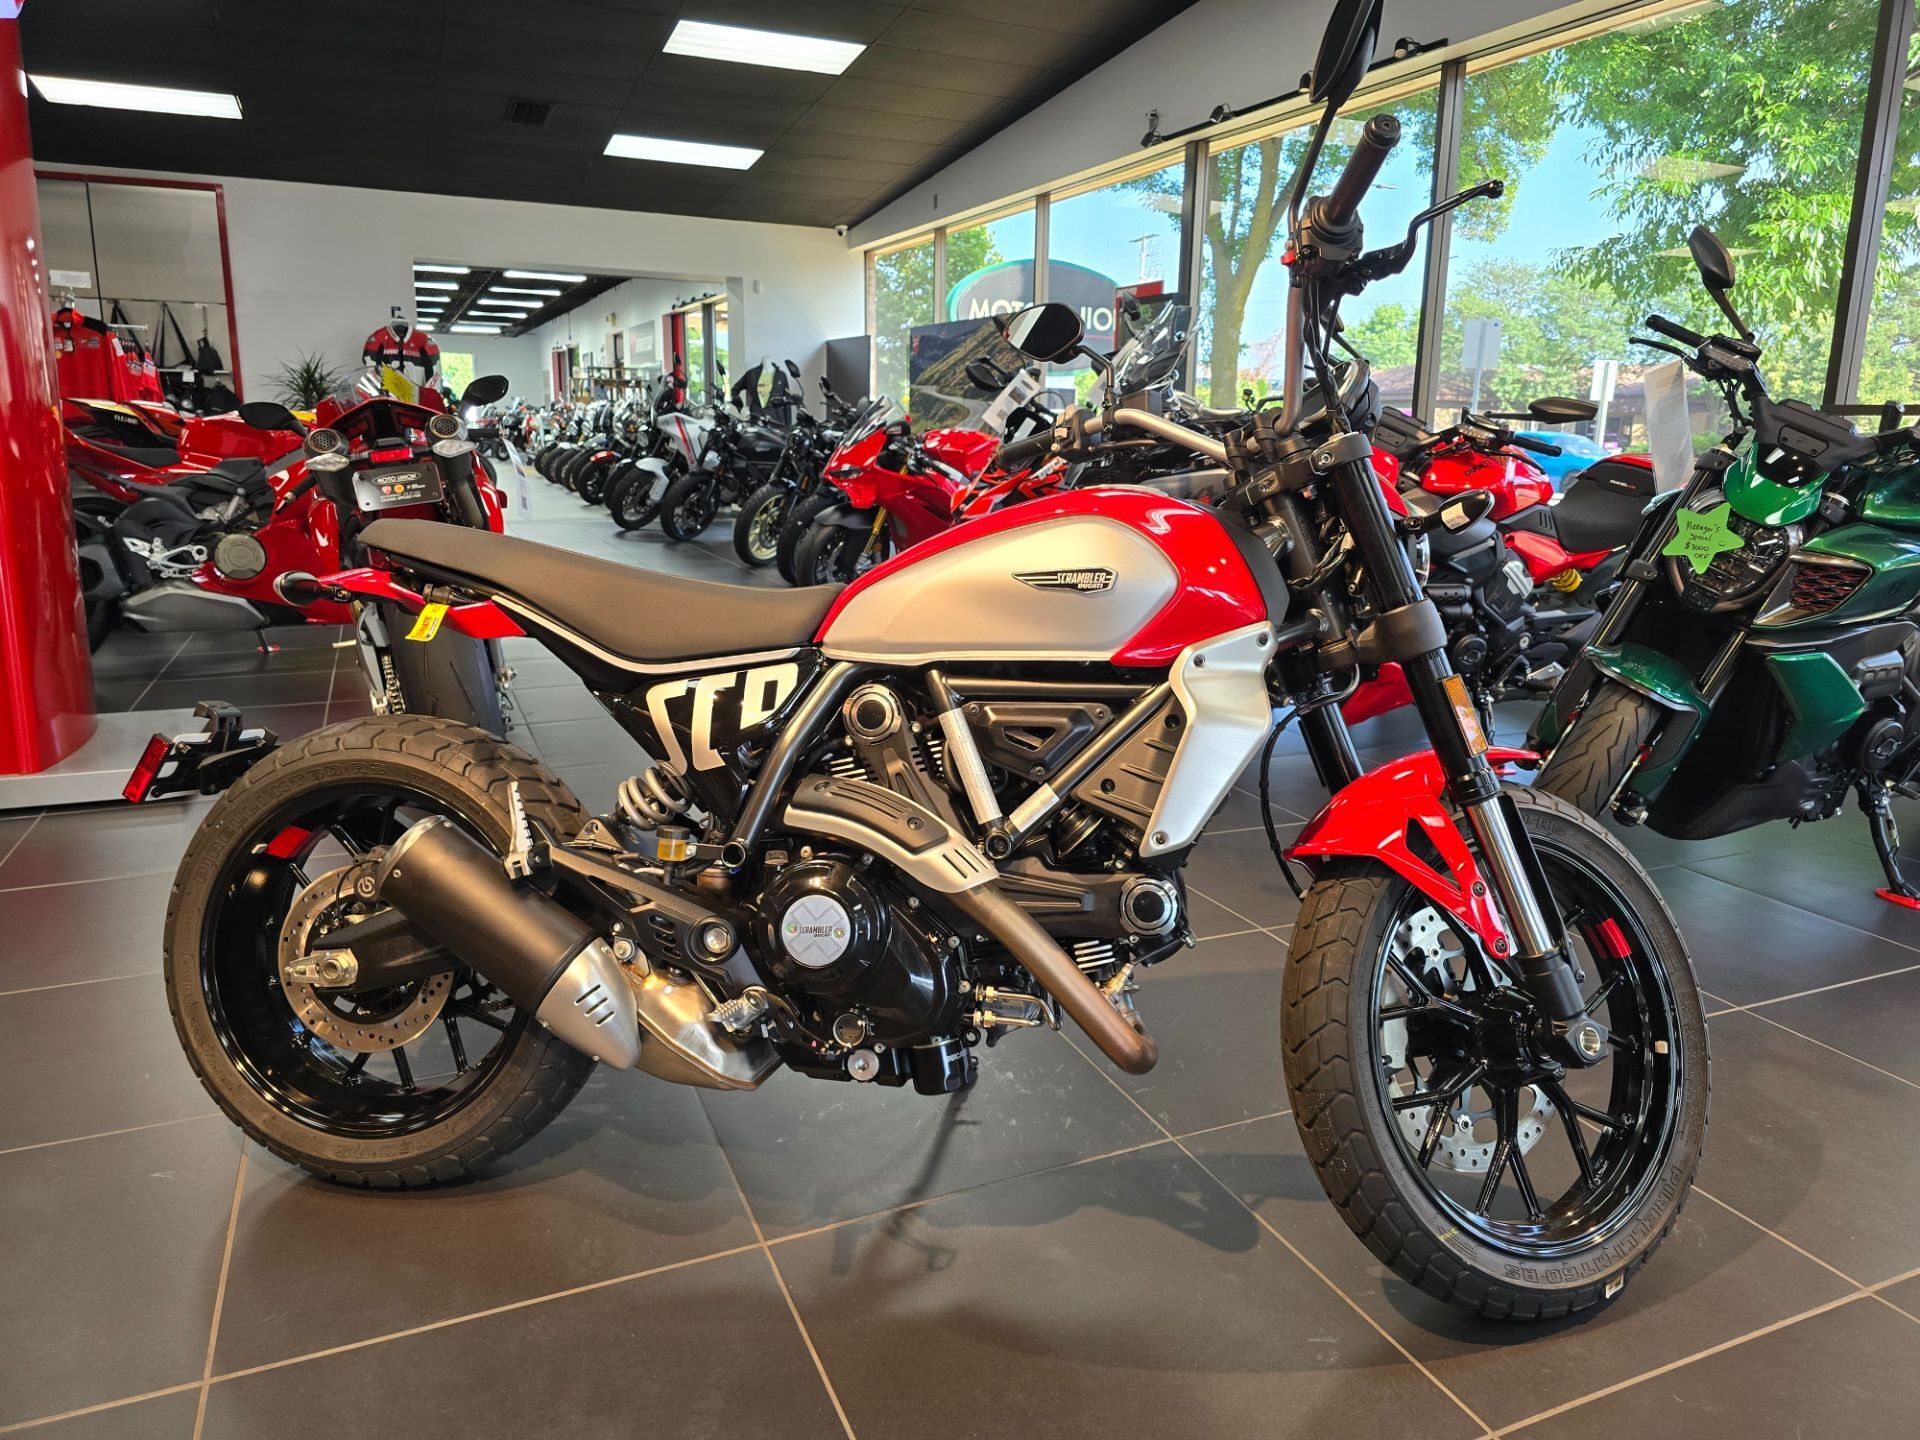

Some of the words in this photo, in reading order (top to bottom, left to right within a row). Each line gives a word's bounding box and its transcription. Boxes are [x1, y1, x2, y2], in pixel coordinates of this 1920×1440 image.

[397, 473, 417, 481] UNION
[1057, 572, 1106, 585] SCRAMBLER
[194, 793, 271, 884] PIRELLI
[799, 925, 833, 934] SCRAMBLER
[1614, 1165, 1685, 1260] PIRELLI
